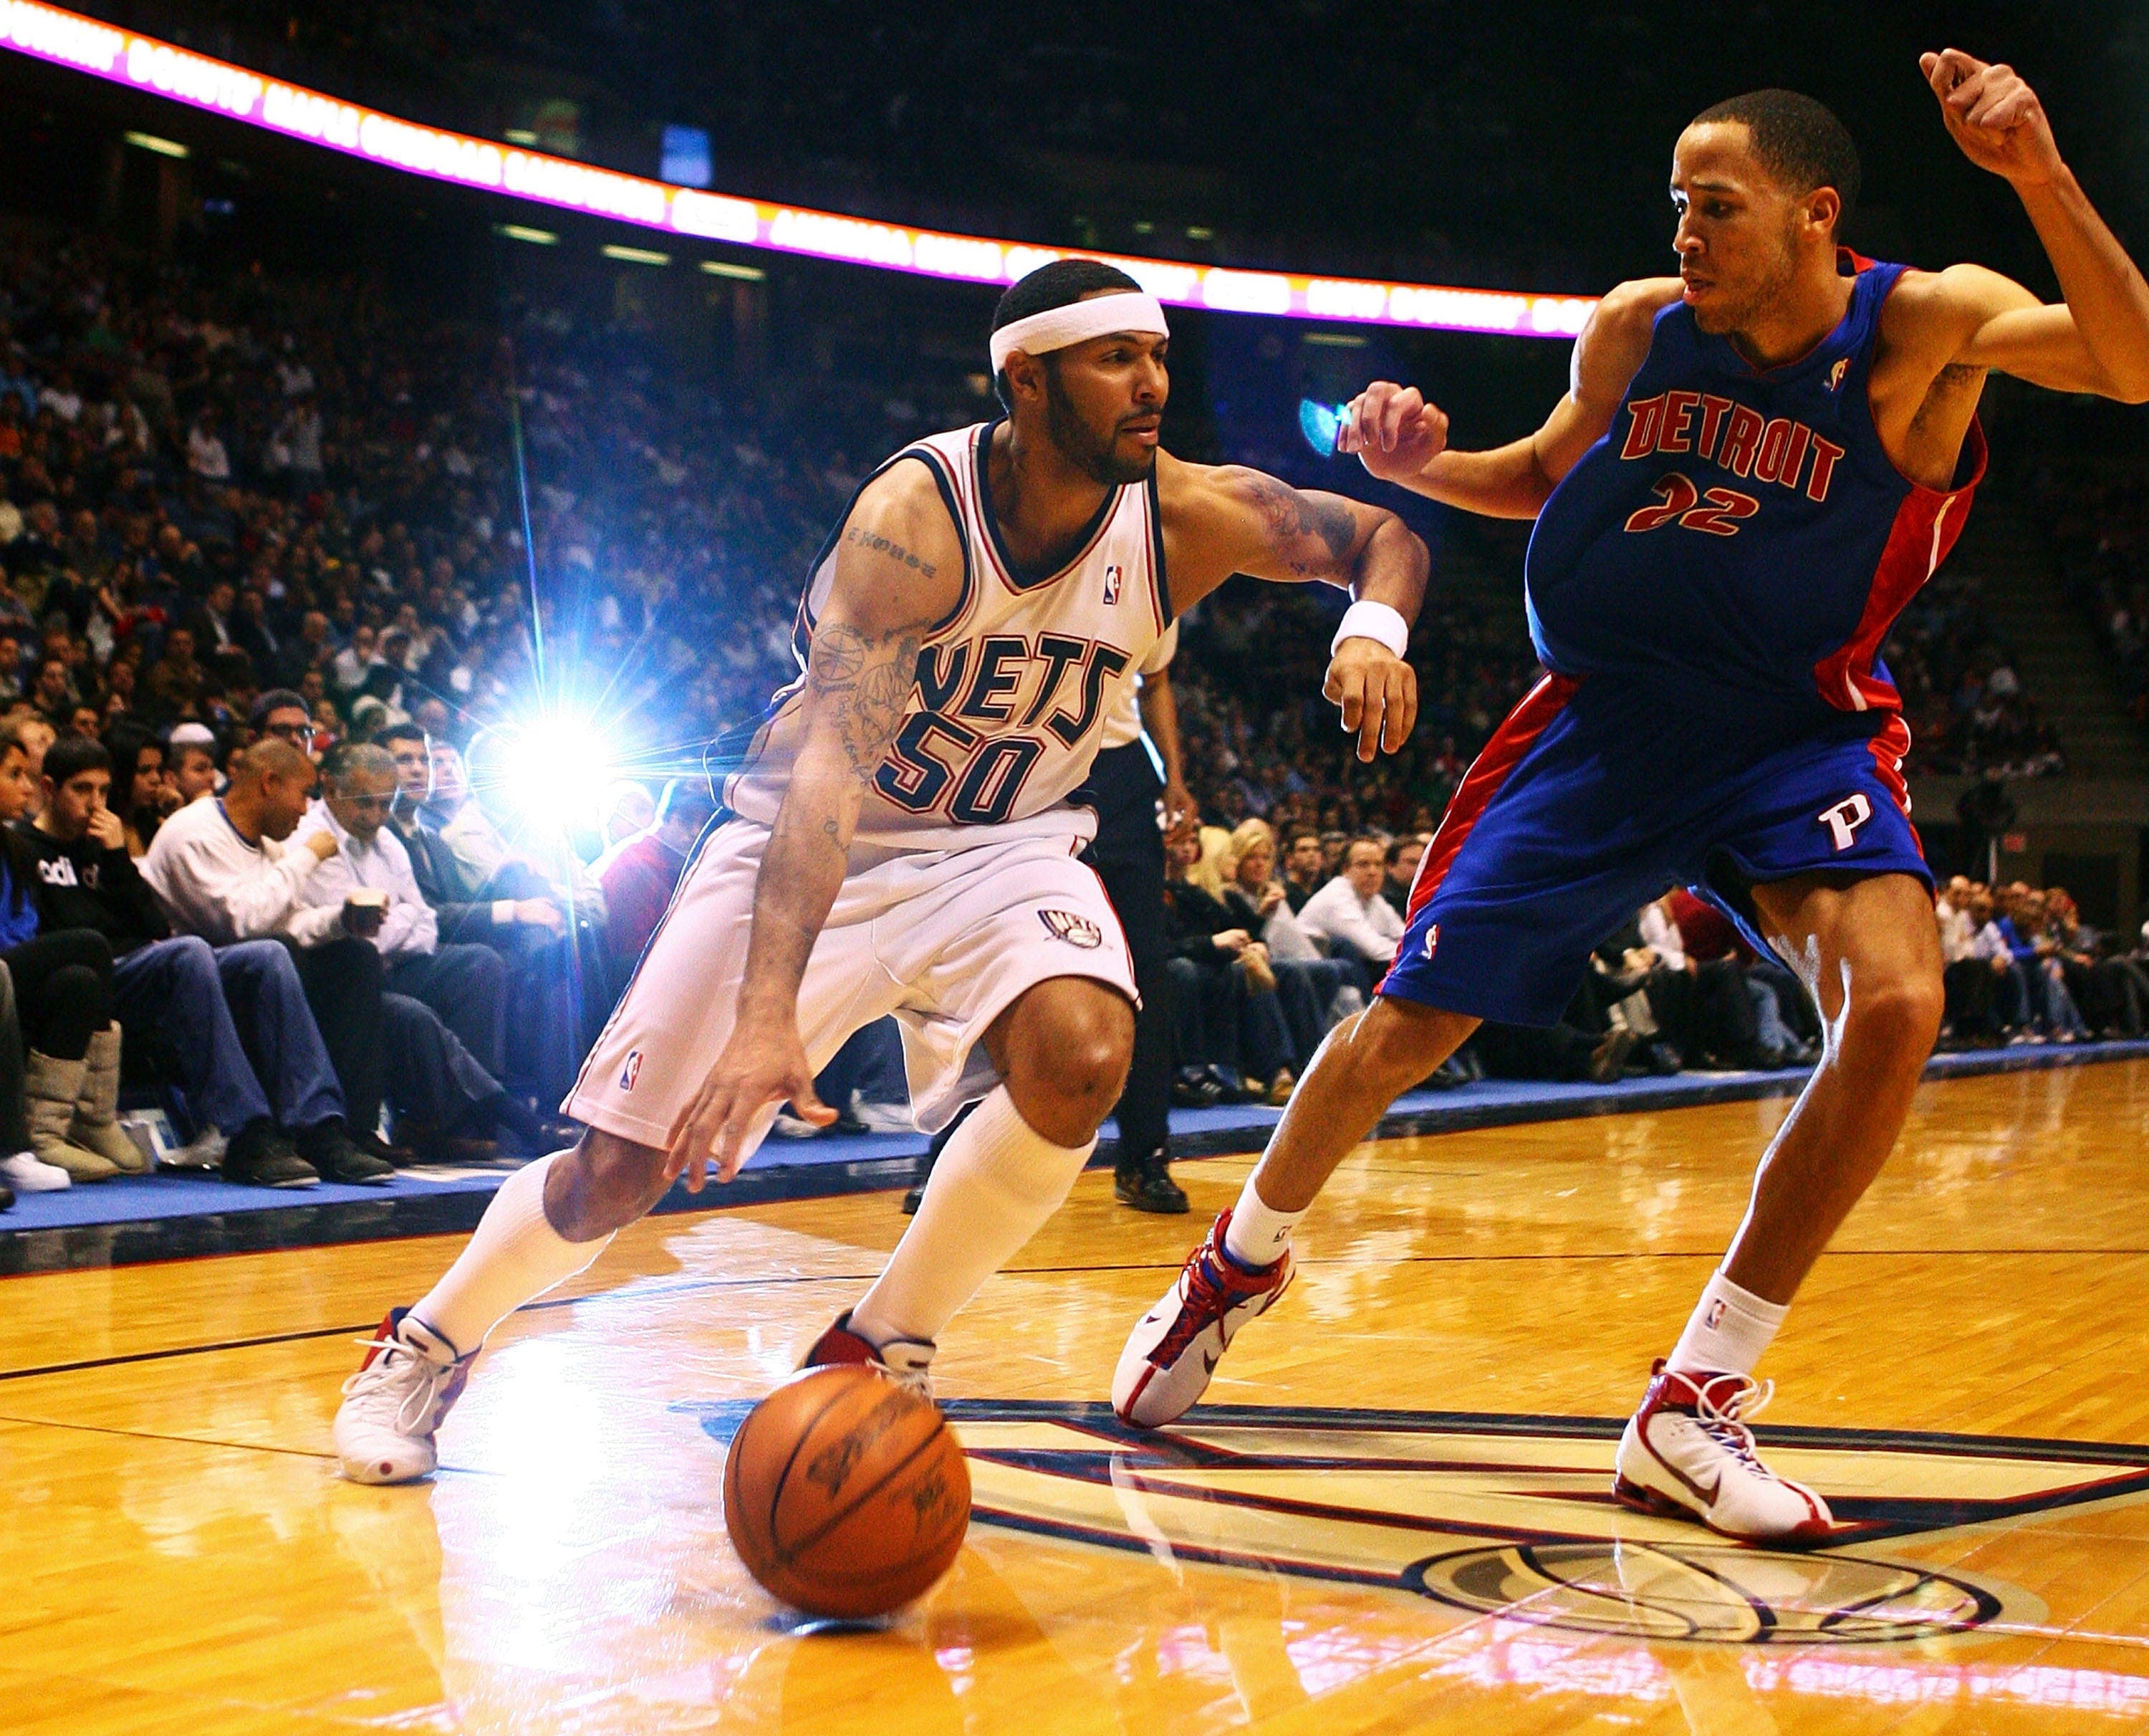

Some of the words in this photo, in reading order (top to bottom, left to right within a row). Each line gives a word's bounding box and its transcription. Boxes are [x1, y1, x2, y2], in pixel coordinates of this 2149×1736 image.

[1620, 390, 1845, 503] DETROIT
[1623, 471, 1760, 536] 22
[904, 631, 1133, 751] NETS
[870, 710, 1047, 824] 50
[1817, 792, 1873, 852] P
